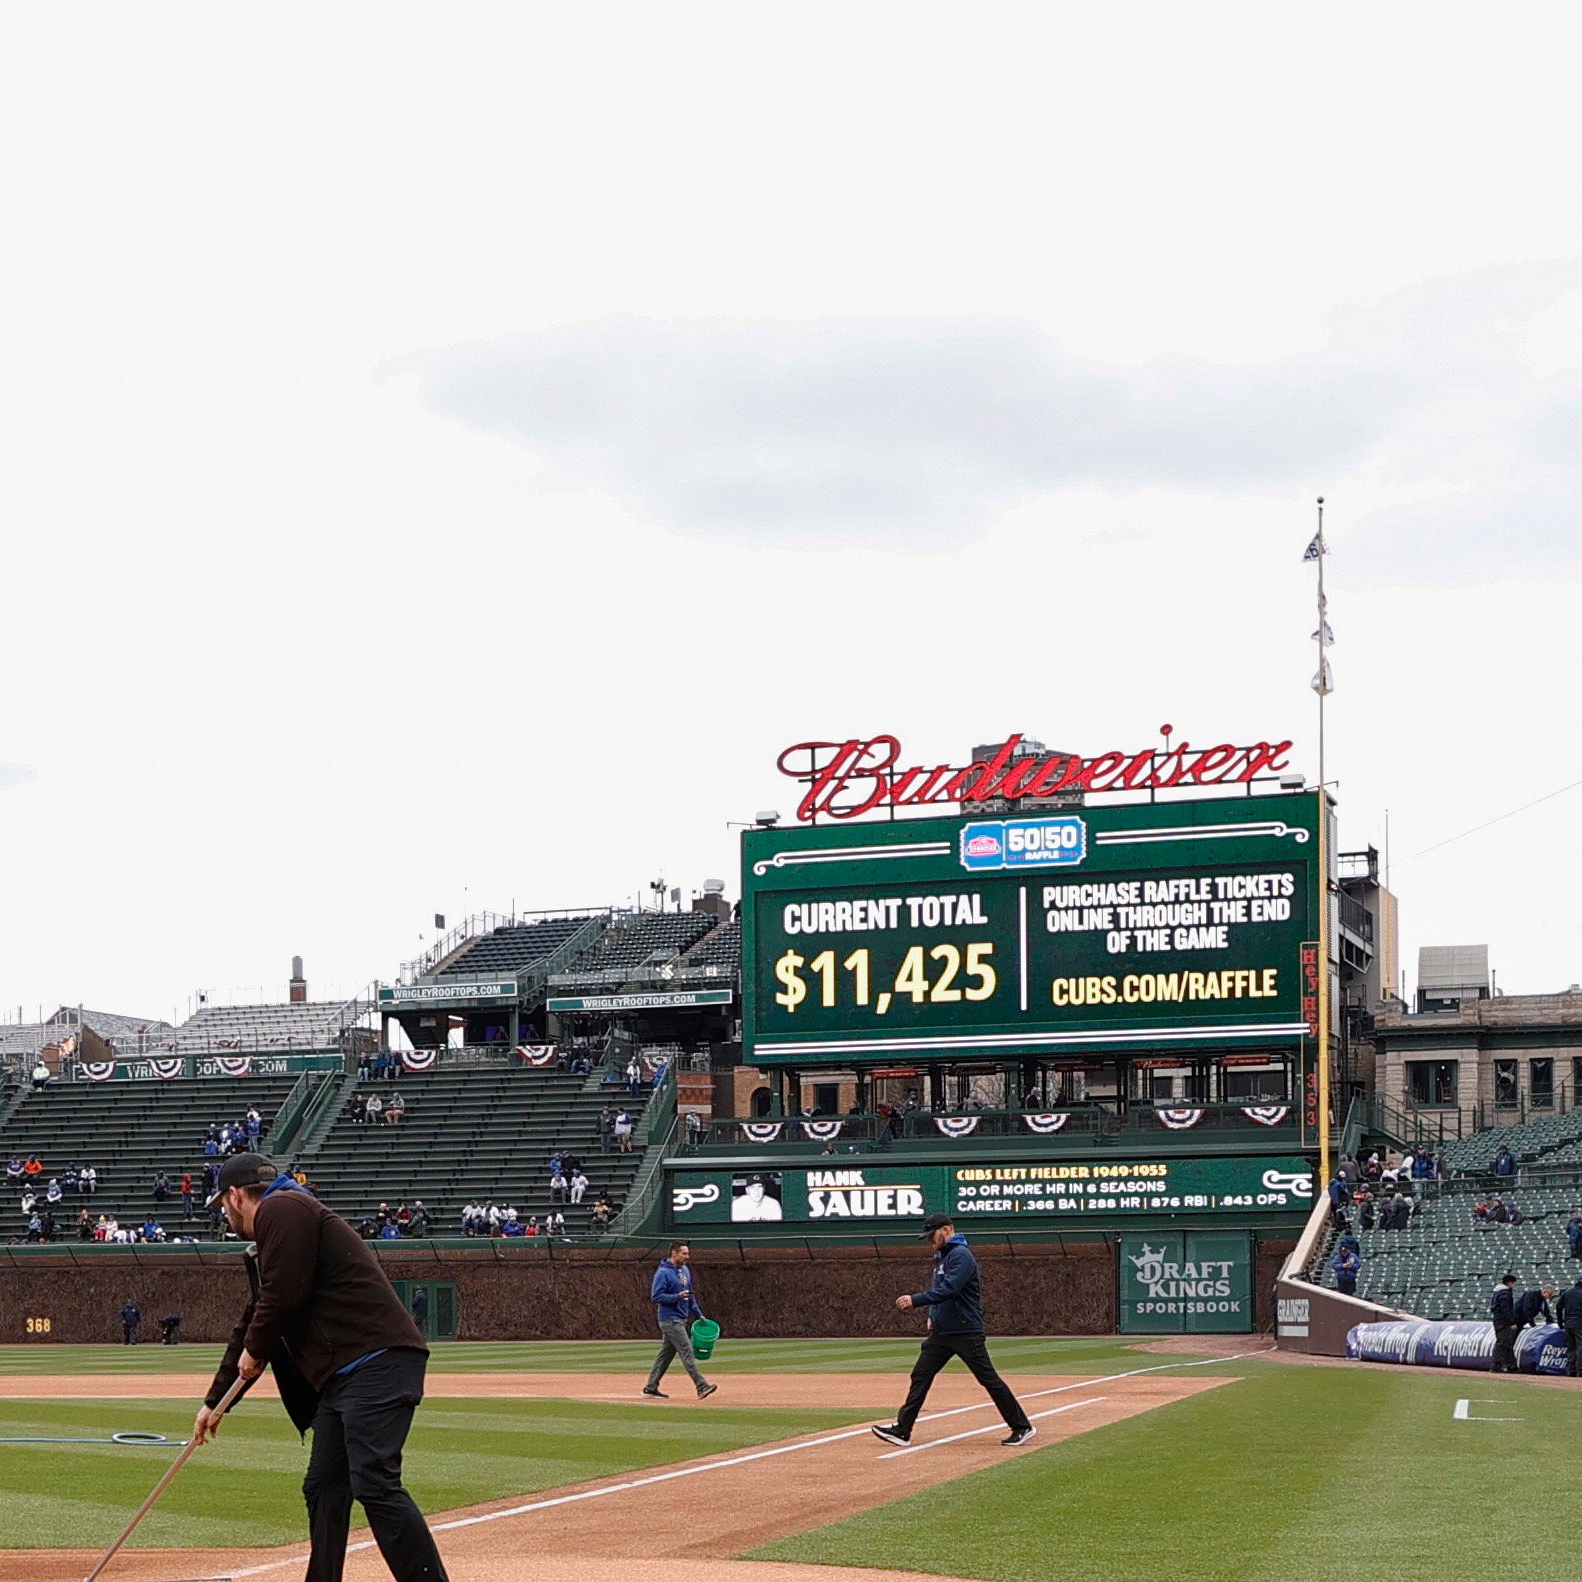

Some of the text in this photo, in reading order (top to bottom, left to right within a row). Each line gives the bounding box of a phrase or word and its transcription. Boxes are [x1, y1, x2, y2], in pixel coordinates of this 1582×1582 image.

[777, 723, 1294, 822] Budweiser
[1025, 850, 1060, 860] RAFFLE
[1043, 873, 1294, 908] PURCHASE RAFFLE TICKETS
[783, 894, 988, 934] CURRENT TOTAL
[1046, 898, 1290, 932] ONLINE THROUGH THE END
[1106, 926, 1228, 953] OF THE GAME
[775, 942, 997, 1014] $11,425
[1052, 969, 1278, 1007] CUBS.COM/RAFFLE
[807, 1170, 865, 1187] HANK
[956, 1169, 992, 1181] CUBS
[995, 1168, 1027, 1180] LEFT
[1030, 1166, 1089, 1180] FIELDER
[957, 1181, 1167, 1197] 30 OR MORE HR IN 6 SEASONS
[808, 1189, 924, 1217] SAUER
[957, 1199, 1012, 1212] CAREER
[1058, 1199, 1077, 1210] BA
[1120, 1197, 1140, 1208] HR
[1151, 1197, 1180, 1208] 876
[1184, 1195, 1207, 1207] RBI
[1219, 1195, 1253, 1206] .843
[1257, 1193, 1287, 1205] OPS
[1136, 1261, 1235, 1284] DRAFT
[1148, 1280, 1231, 1298] KINGS
[1136, 1300, 1241, 1314] SPORTSBOOK
[1278, 1298, 1310, 1322] GRAINGER
[26, 1318, 51, 1332] 368
